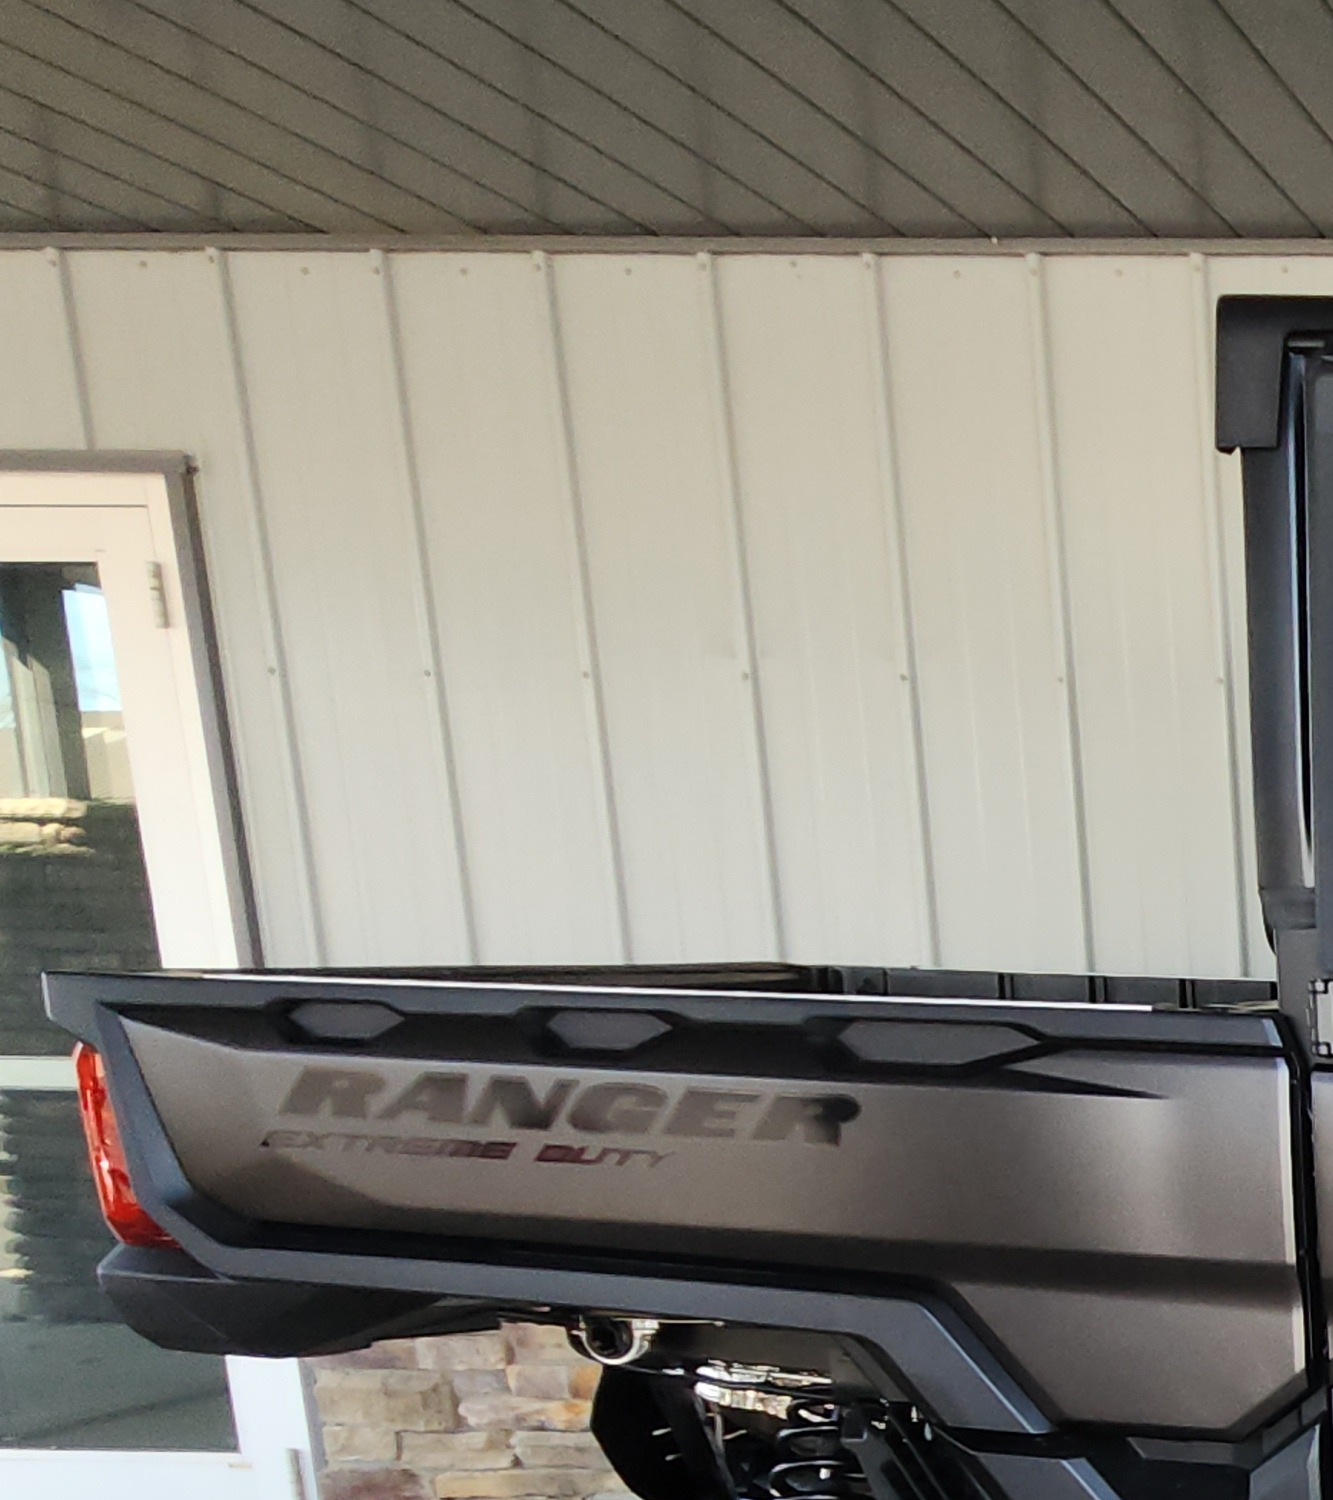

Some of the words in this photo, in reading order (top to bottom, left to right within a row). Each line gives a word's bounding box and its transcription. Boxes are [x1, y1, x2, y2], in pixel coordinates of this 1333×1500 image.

[278, 1064, 862, 1147] RANGER
[260, 1129, 518, 1161] EXTREME
[534, 1143, 676, 1168] DUTY
